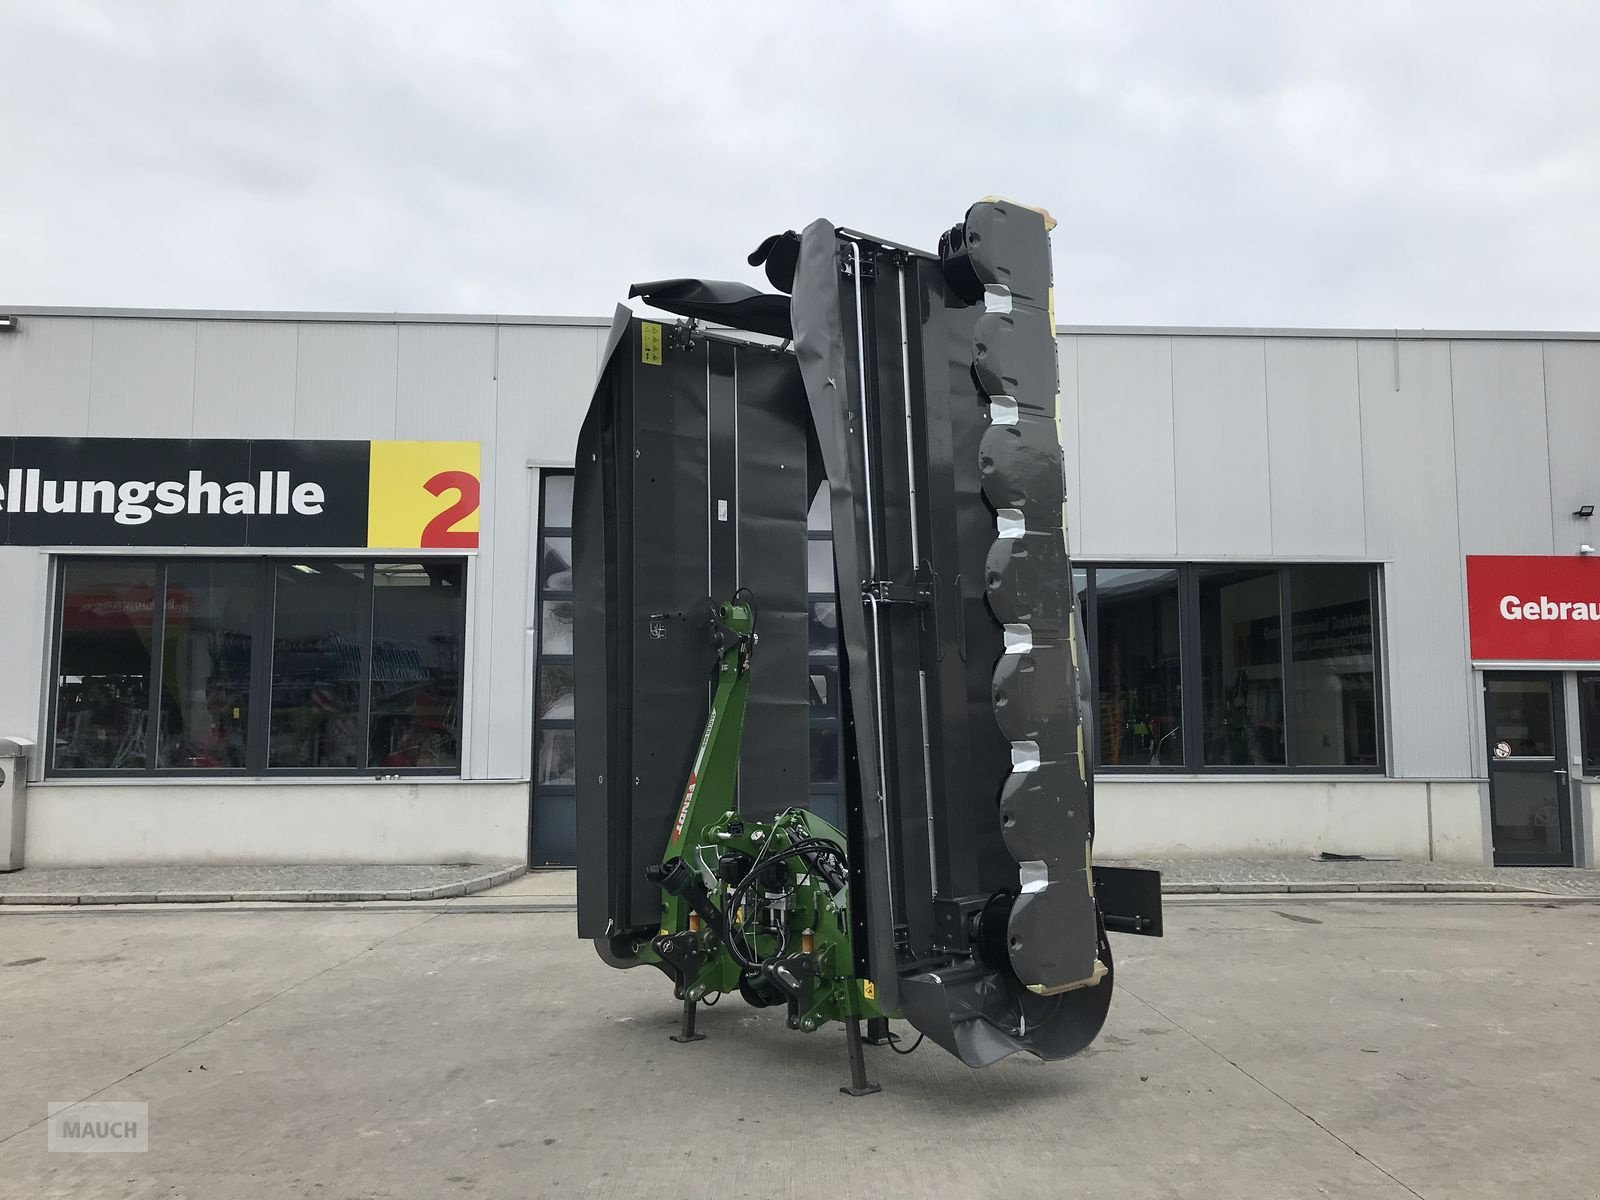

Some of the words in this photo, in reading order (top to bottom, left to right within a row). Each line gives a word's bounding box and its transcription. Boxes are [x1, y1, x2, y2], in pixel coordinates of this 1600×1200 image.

[0, 468, 325, 525] llungshalle
[420, 470, 480, 548] 2
[676, 784, 696, 835] FENDT
